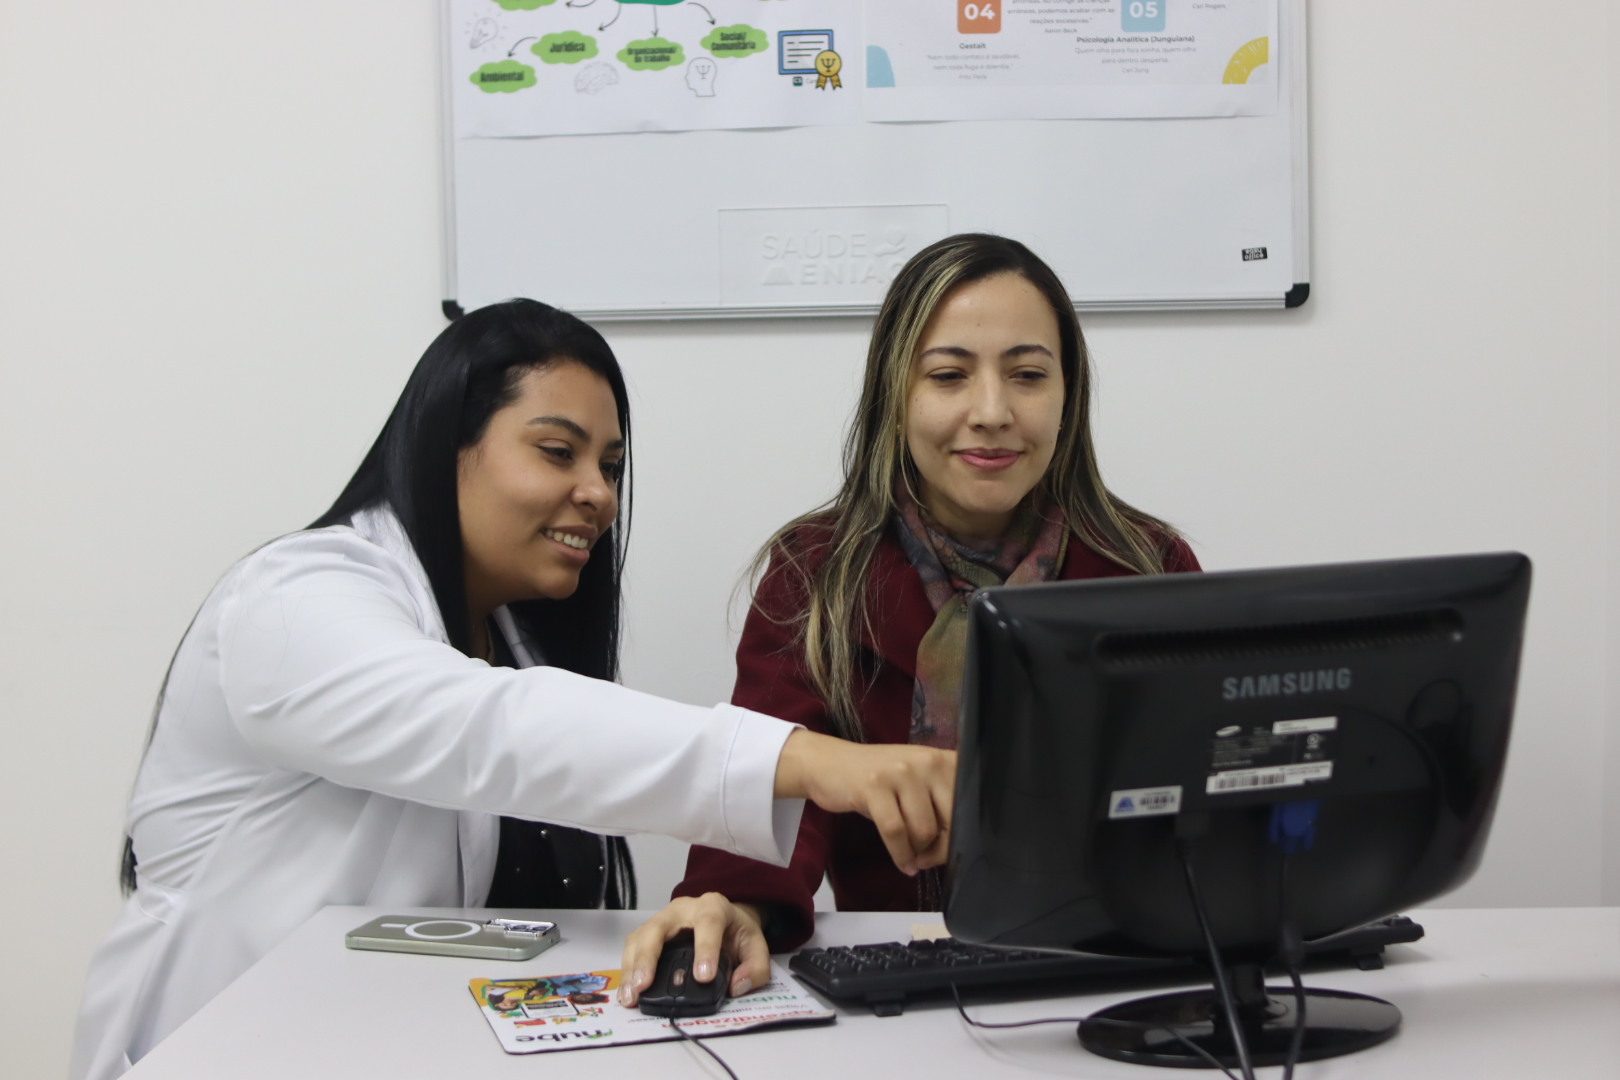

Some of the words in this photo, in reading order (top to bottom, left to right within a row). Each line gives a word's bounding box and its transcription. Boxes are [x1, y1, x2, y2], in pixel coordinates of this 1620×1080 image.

[963, 3, 996, 20] 04
[1129, 0, 1158, 18] 05
[1076, 36, 1115, 44] Psicologia
[1116, 35, 1149, 43] Analítica
[1150, 34, 1196, 43] (Junguiana)
[549, 41, 585, 53] Jurídica
[480, 70, 525, 82] Ambiental
[761, 229, 867, 260] SAÚDE
[1222, 668, 1352, 700] SAMSUNG
[515, 1028, 606, 1042] nube
